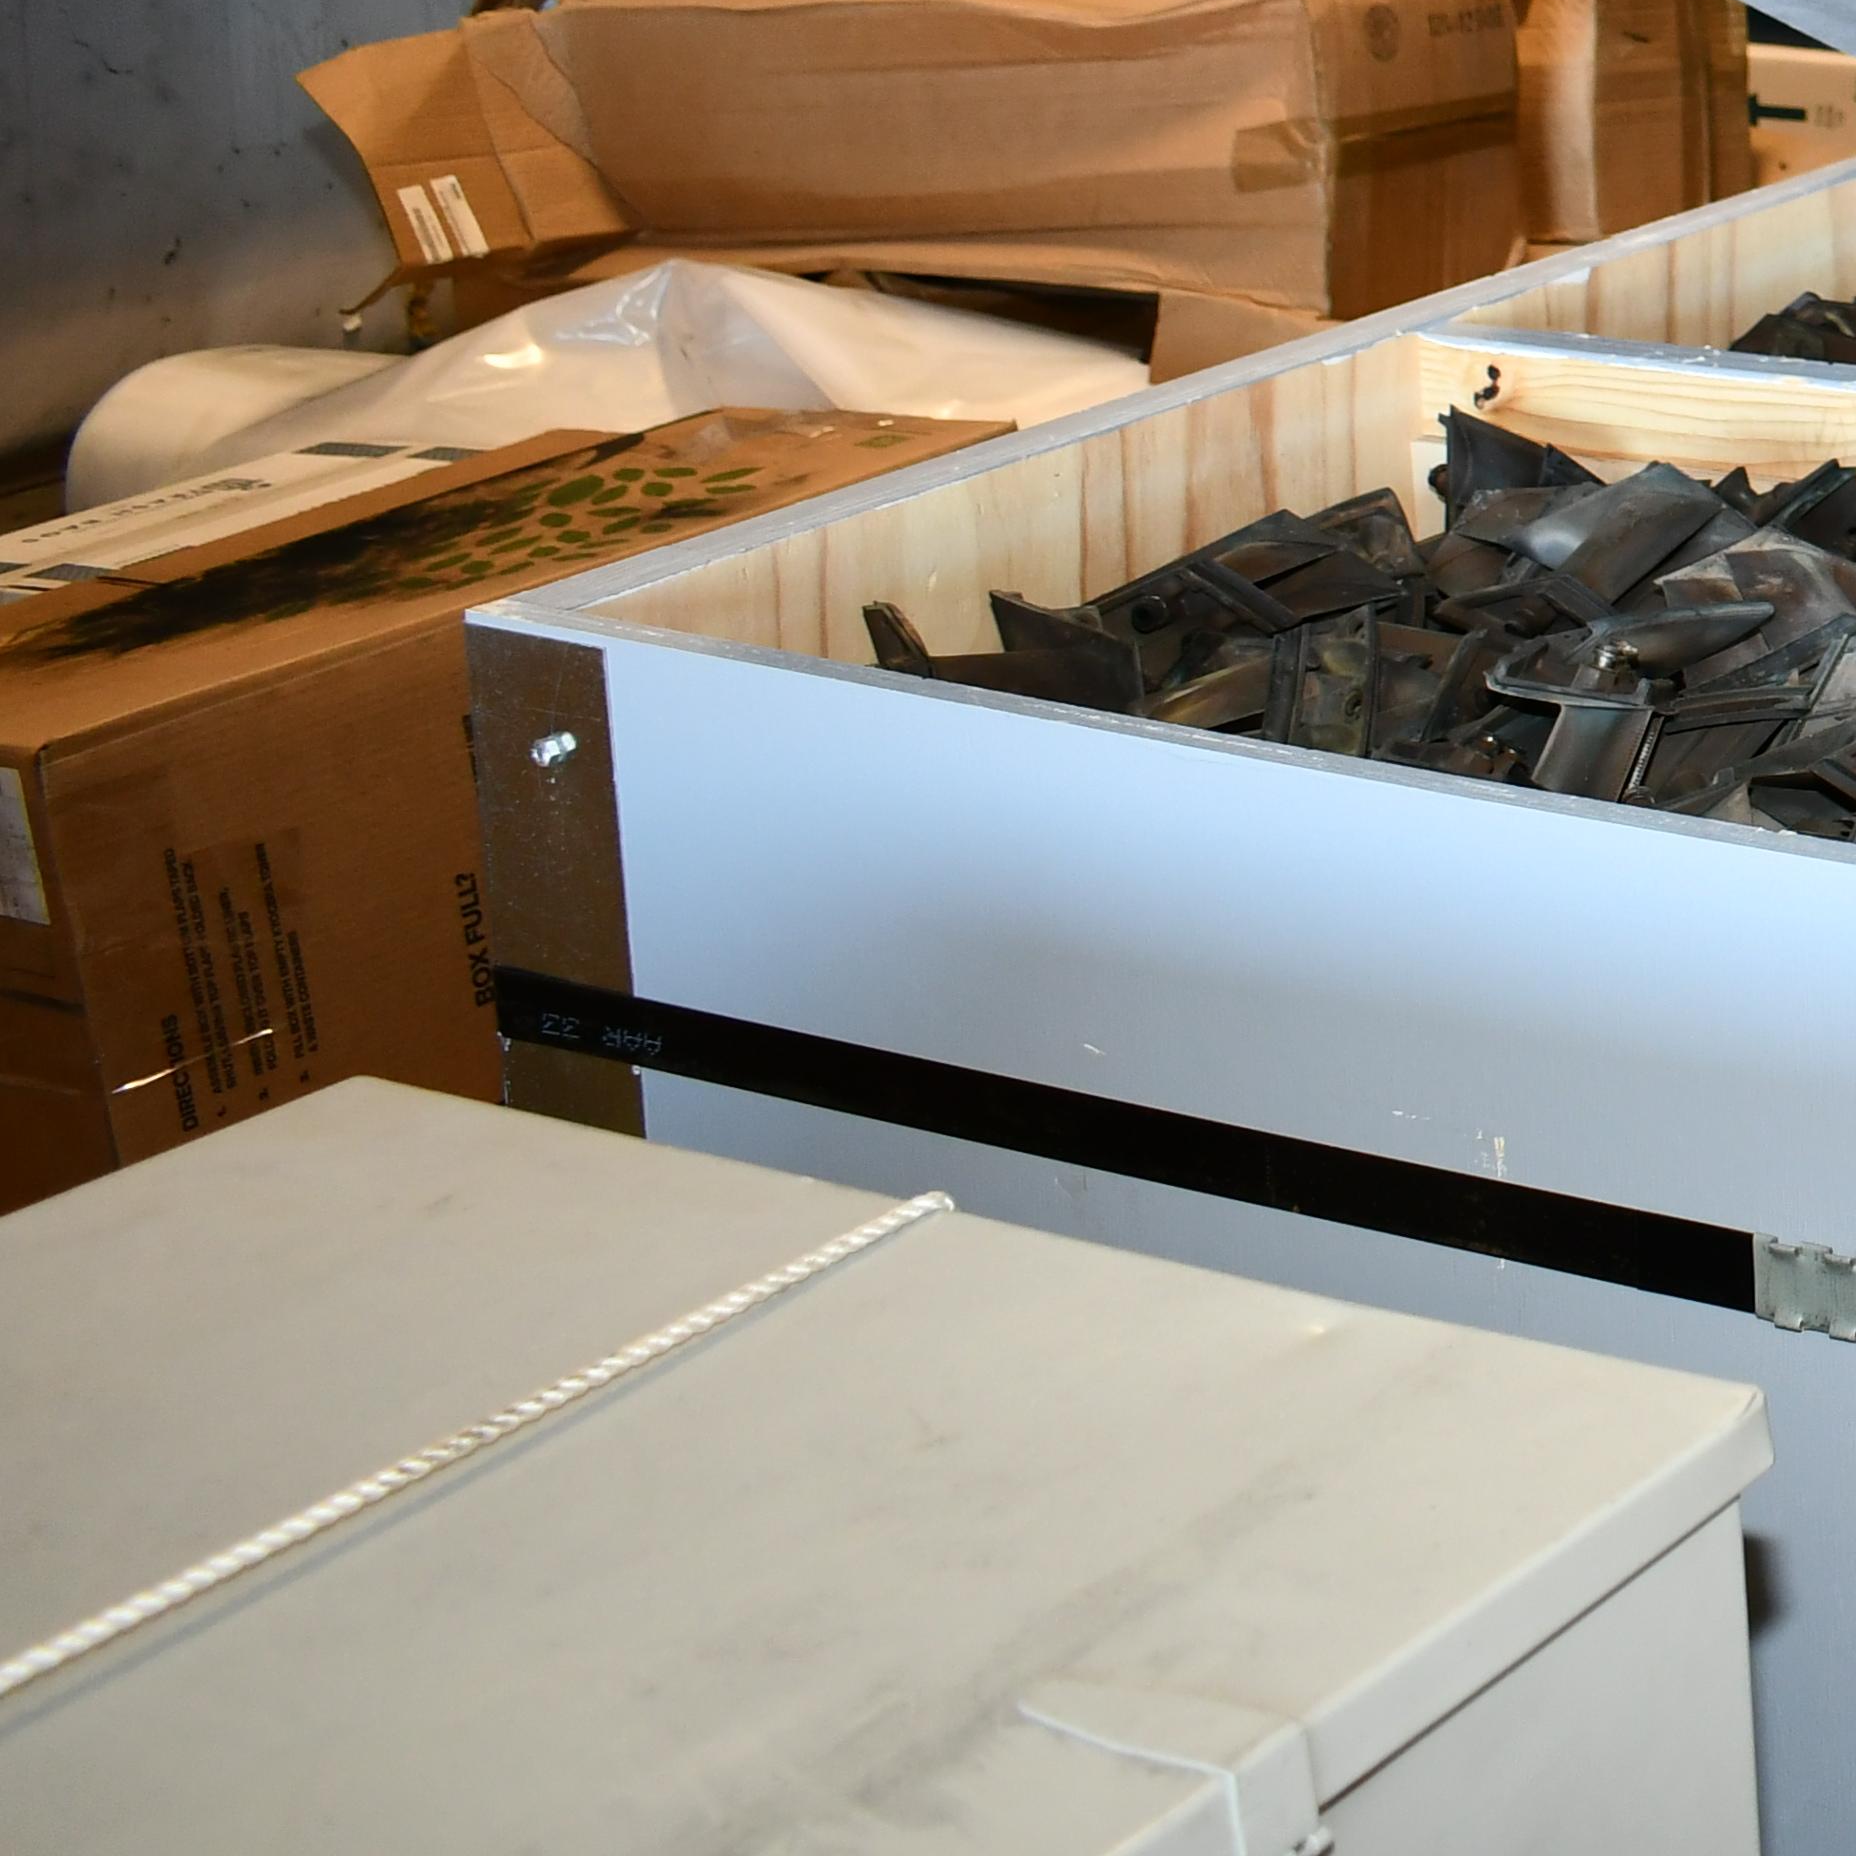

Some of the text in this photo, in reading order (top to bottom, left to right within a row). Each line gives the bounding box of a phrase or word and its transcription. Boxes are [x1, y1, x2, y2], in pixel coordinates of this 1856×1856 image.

[455, 871, 495, 1008] BOX FULL?
[161, 1012, 199, 1132] DIRECIONS
